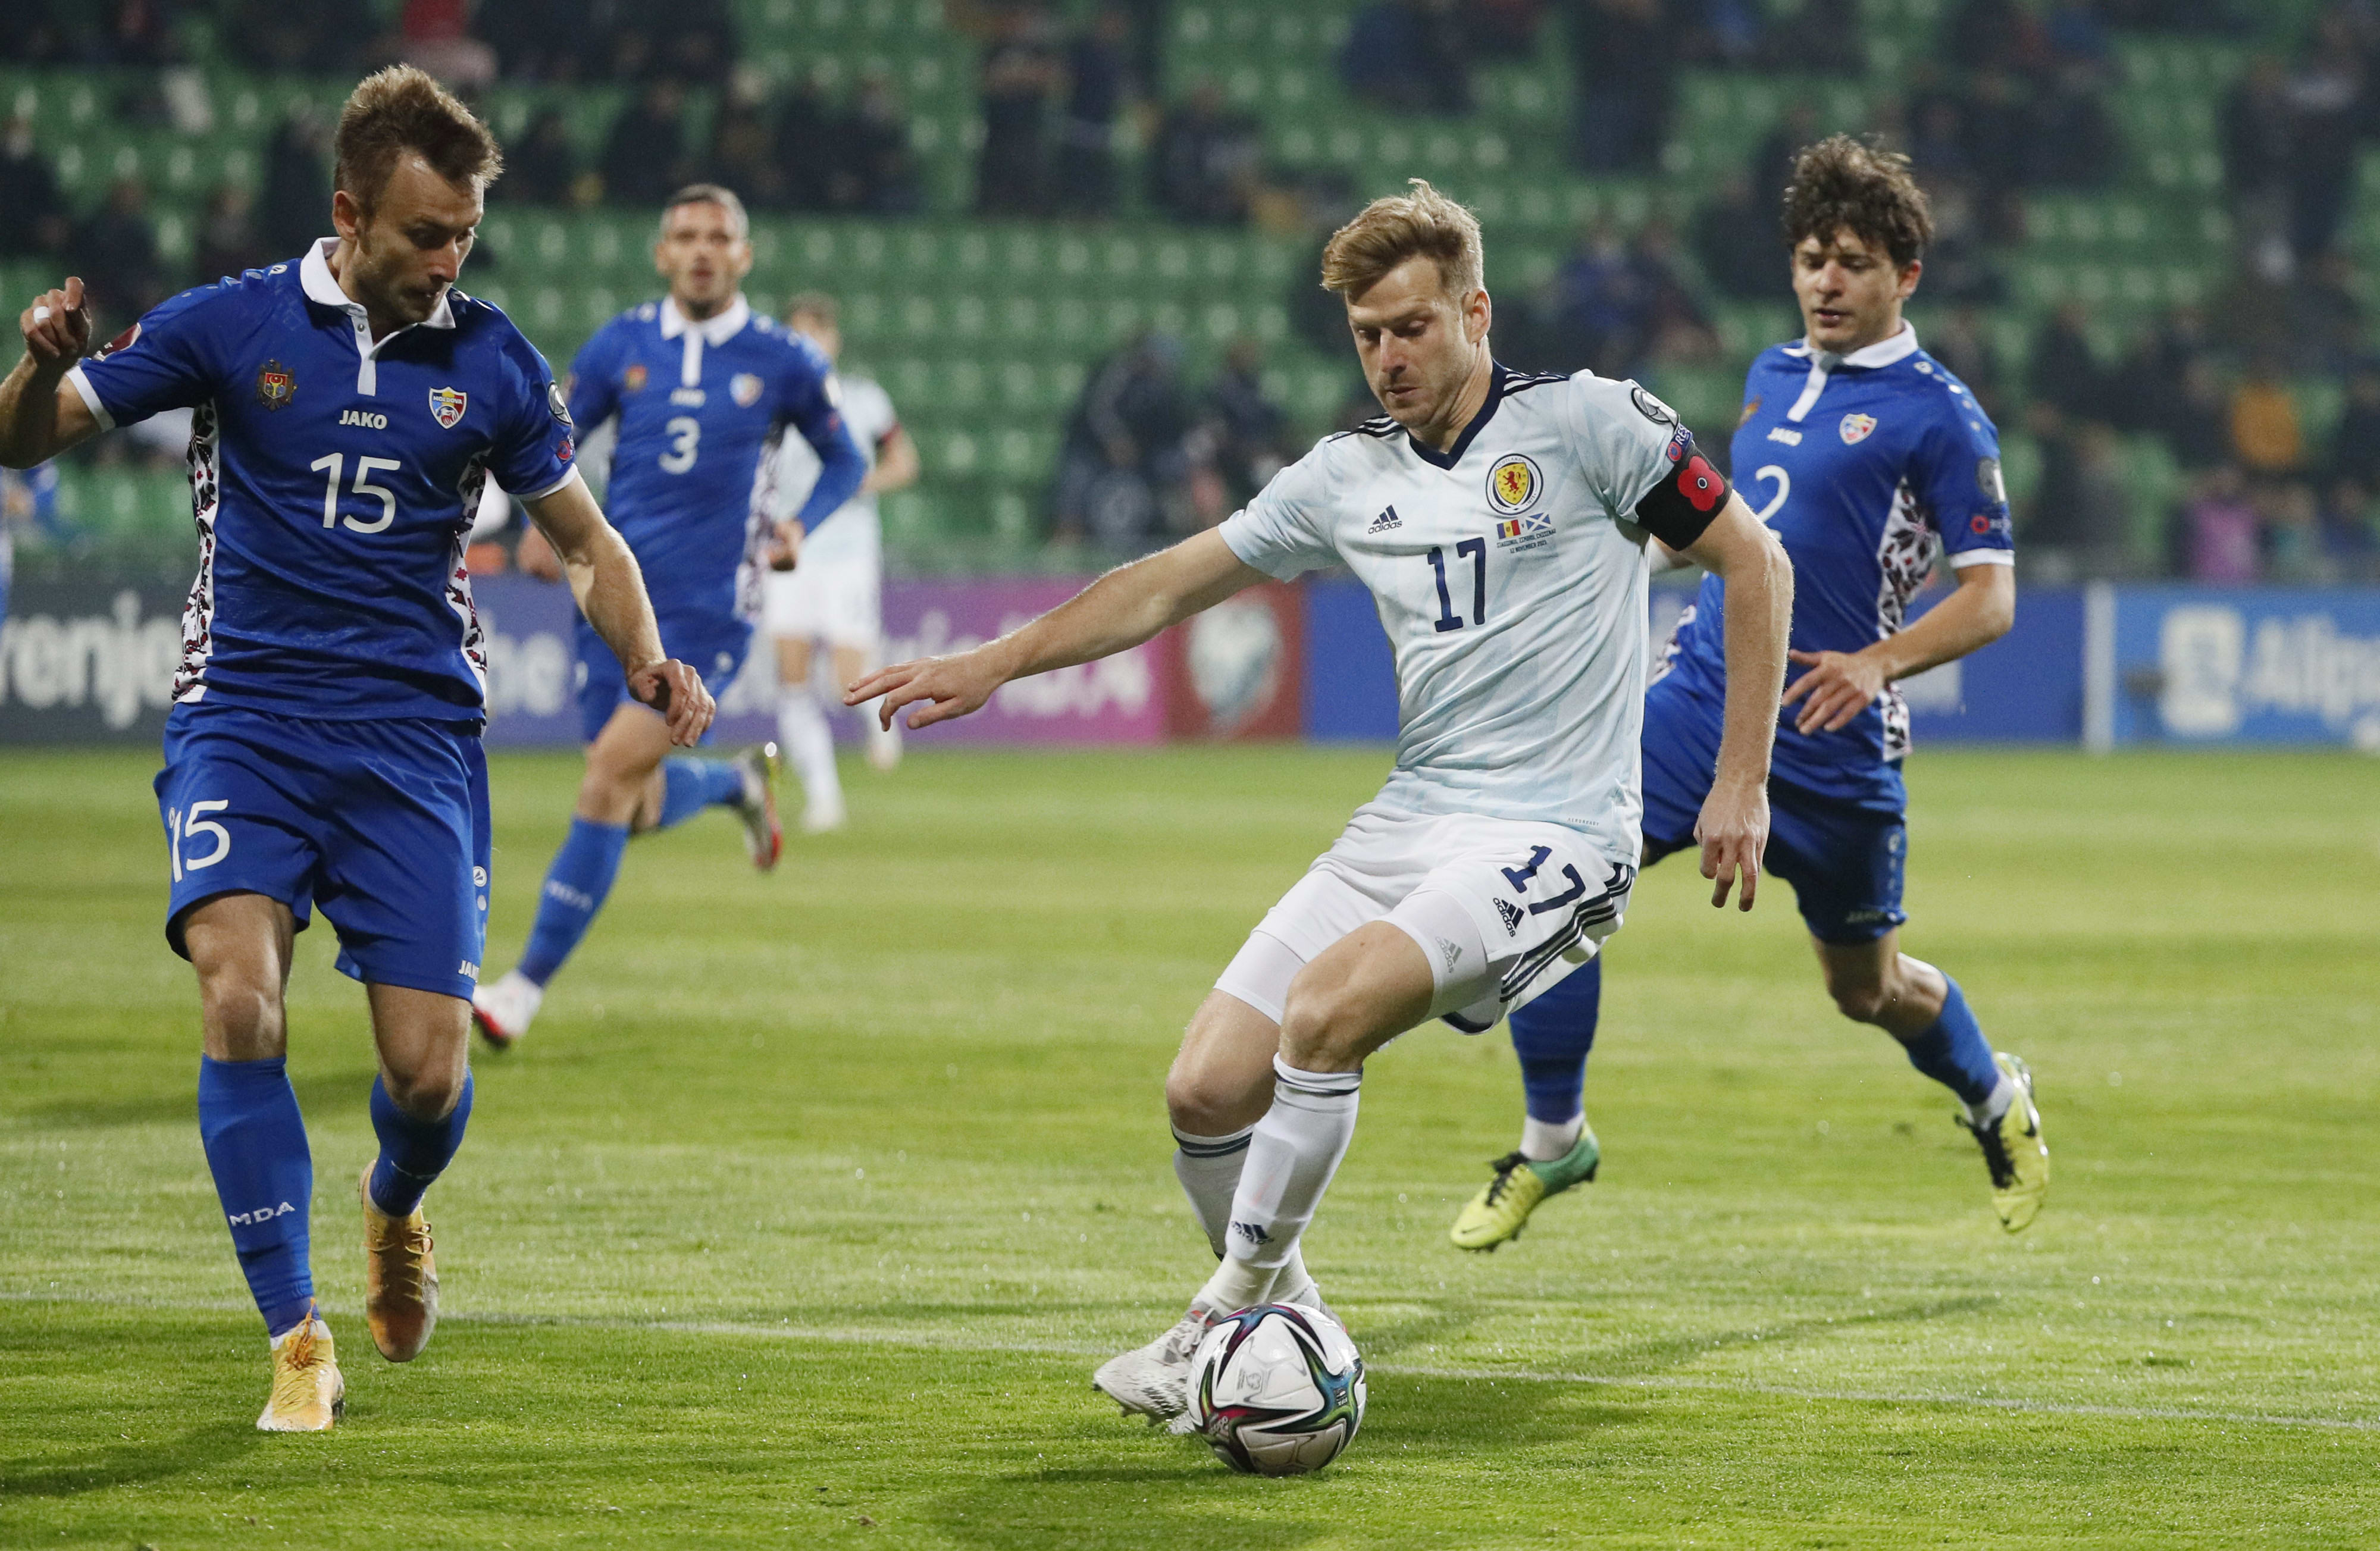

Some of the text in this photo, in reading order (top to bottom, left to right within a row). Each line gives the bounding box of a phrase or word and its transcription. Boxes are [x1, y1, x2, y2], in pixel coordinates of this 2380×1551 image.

[339, 410, 387, 430] JAKO
[433, 396, 463, 405] MOLDOVA
[657, 415, 701, 475] 3
[311, 452, 401, 534] 15
[1755, 465, 1790, 541] 2
[1368, 521, 1402, 534] adidas
[1515, 542, 1536, 552] NOVEMBER
[1427, 537, 1486, 632] 17
[173, 799, 231, 883] 15
[1501, 845, 1586, 916] 17
[1493, 897, 1516, 938] adidas
[229, 1201, 296, 1226] MDA
